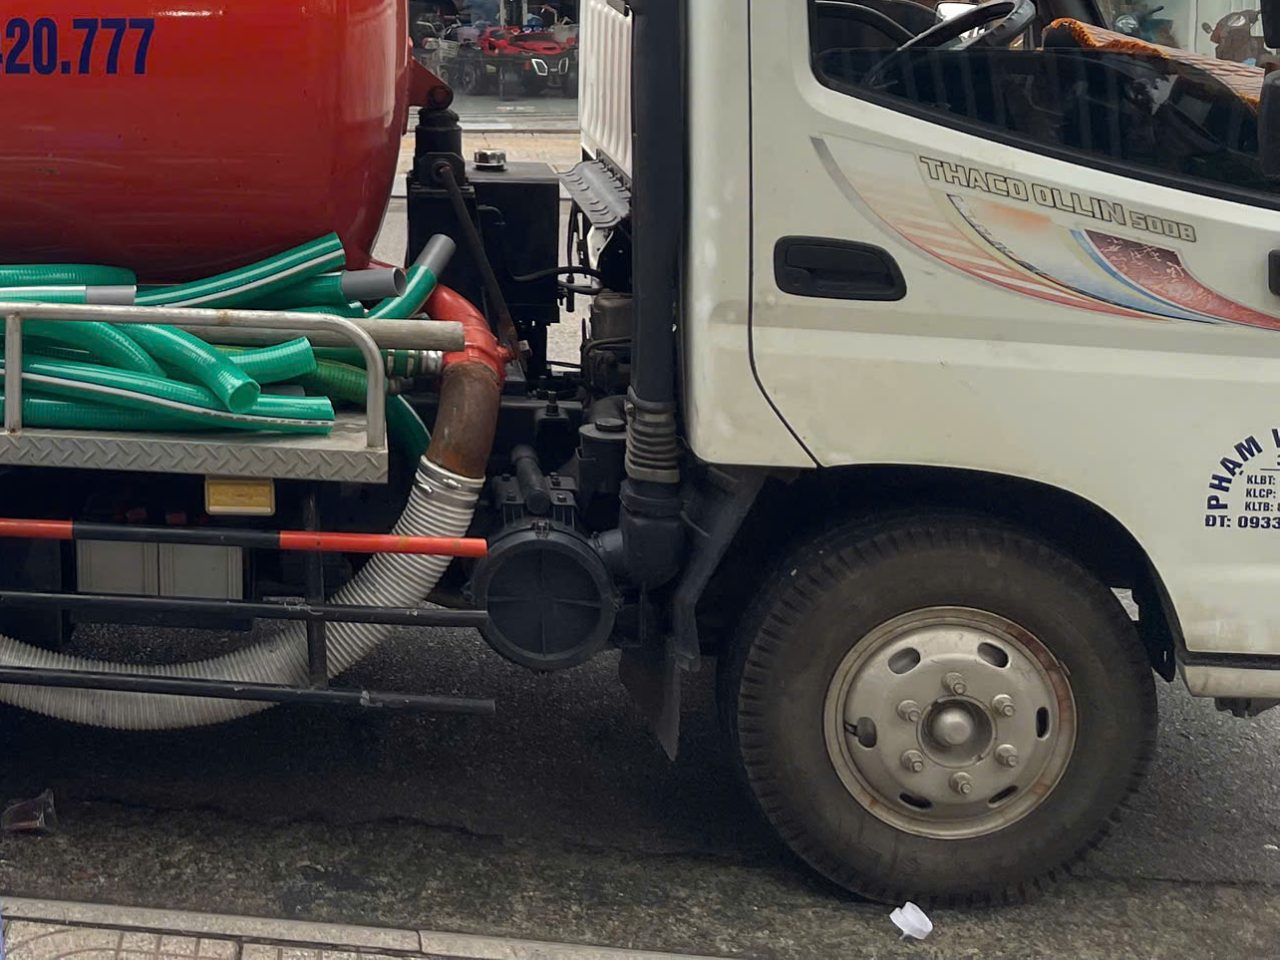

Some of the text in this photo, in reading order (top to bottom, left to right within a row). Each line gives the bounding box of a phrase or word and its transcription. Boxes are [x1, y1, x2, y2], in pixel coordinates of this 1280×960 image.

[920, 156, 1198, 243] THACO OLLIN 500B
[1207, 435, 1263, 510] PHẠM
[1246, 474, 1276, 486] KLBT:
[1245, 487, 1276, 499] KLCP:
[1244, 501, 1274, 512] KLTB:
[1205, 514, 1231, 529] ĐT:
